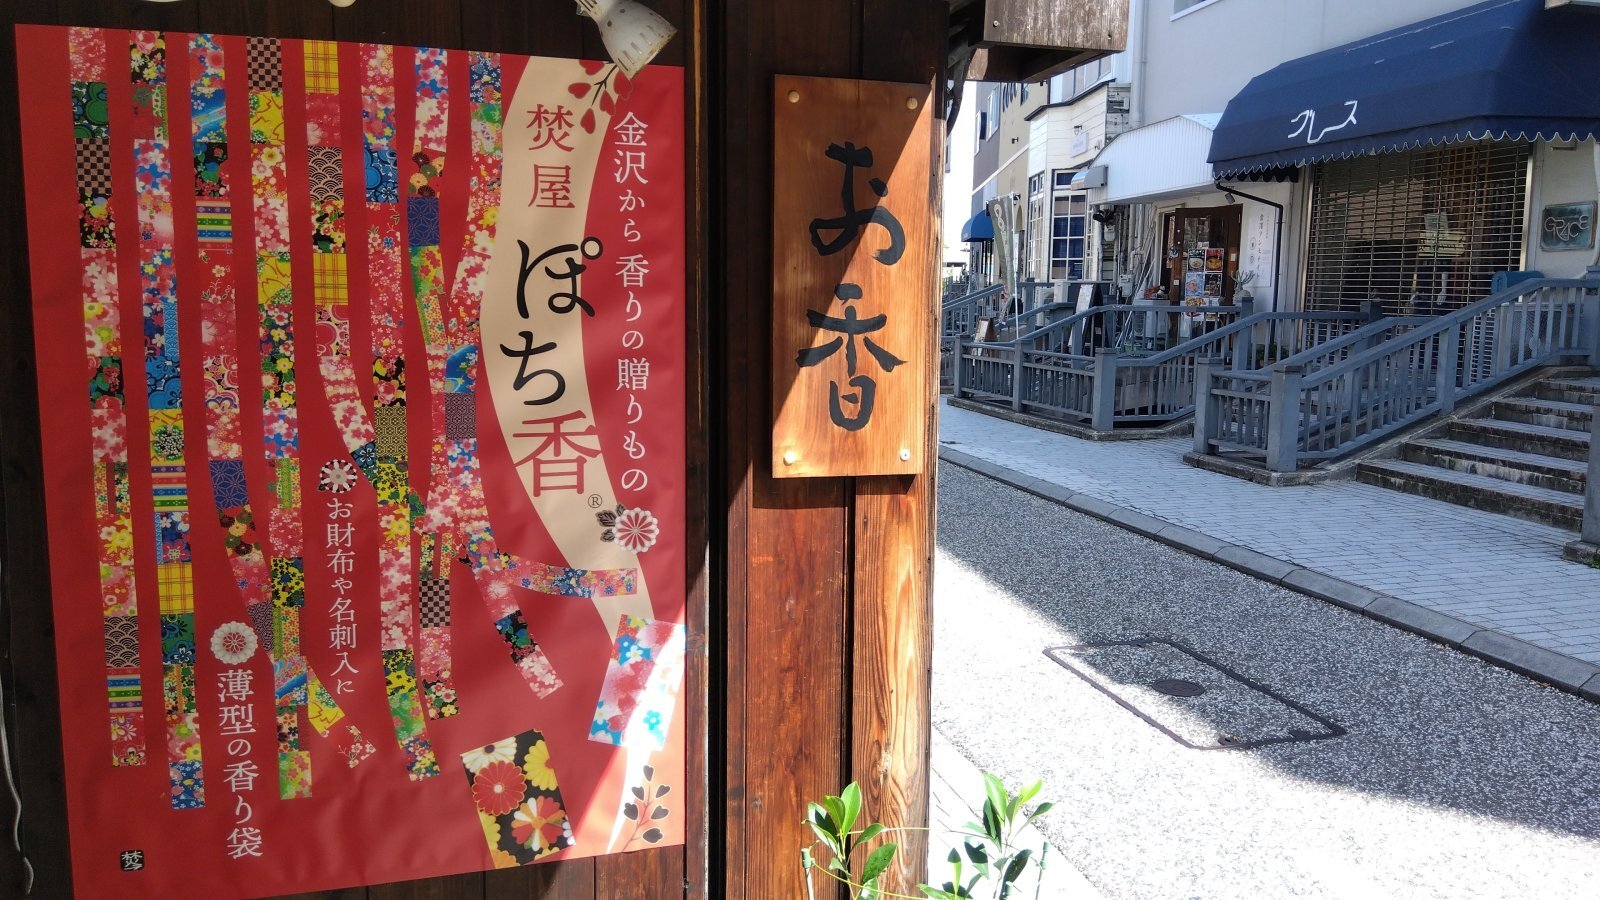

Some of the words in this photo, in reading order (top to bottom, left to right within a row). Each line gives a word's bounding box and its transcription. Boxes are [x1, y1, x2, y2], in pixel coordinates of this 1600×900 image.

[526, 103, 576, 209] 焚屋
[1544, 214, 1590, 241] GRACE
[499, 236, 604, 498] ぽち香
[612, 111, 651, 492] 金沢から香りの贈りもの
[795, 141, 908, 432] お香
[325, 497, 360, 695] お財布や名刺入に
[216, 668, 263, 860] 薄型の香り袋
